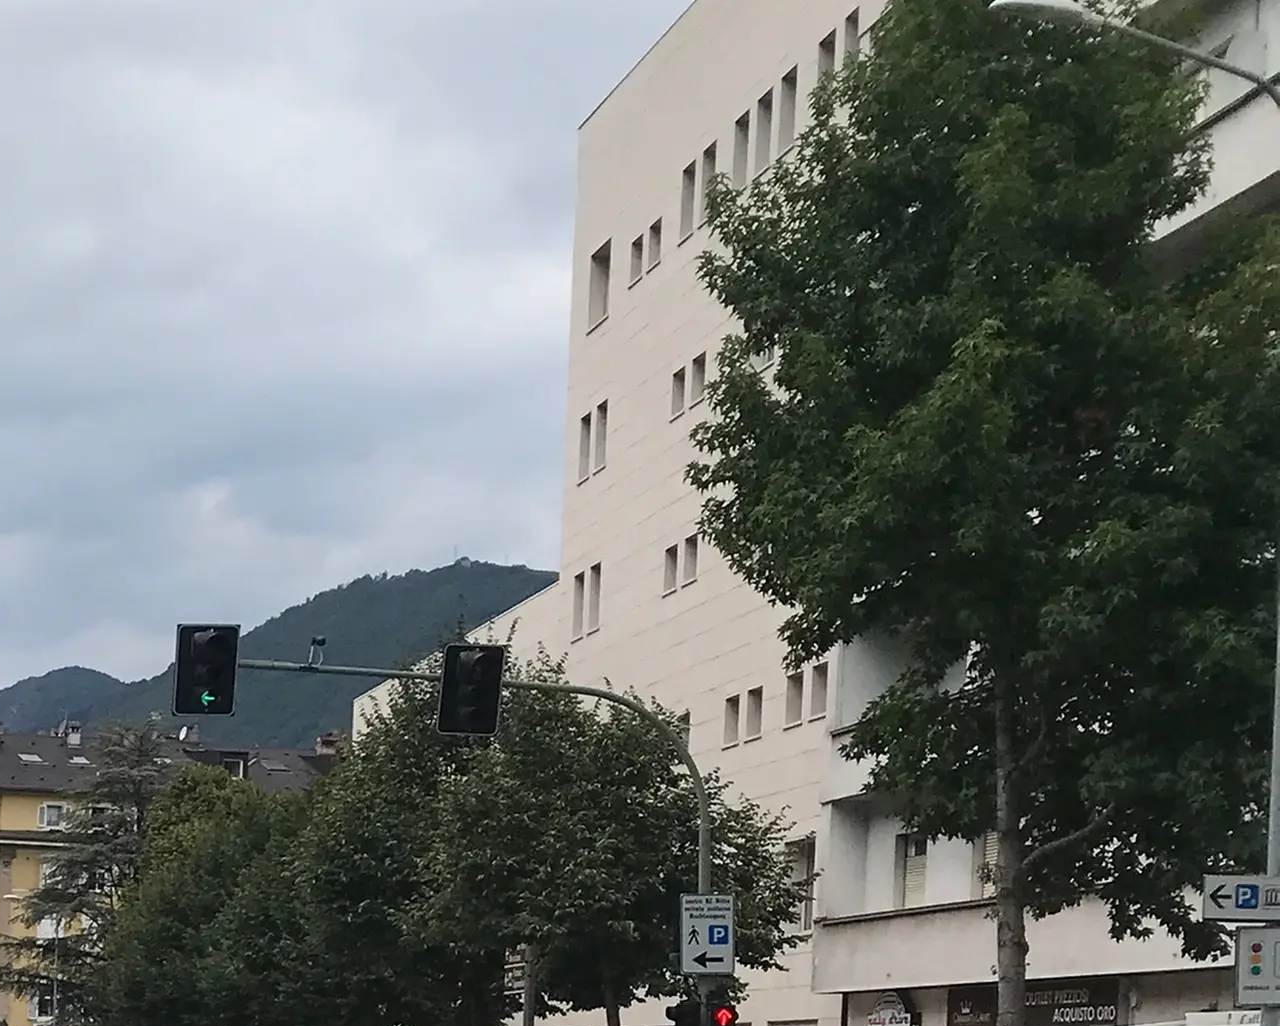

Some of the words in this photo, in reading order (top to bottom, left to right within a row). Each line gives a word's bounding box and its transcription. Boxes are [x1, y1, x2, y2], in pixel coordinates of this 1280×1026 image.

[713, 928, 725, 942] P
[1052, 1008, 1096, 1023] ACQUISTO
[1097, 1006, 1116, 1020] ORO
